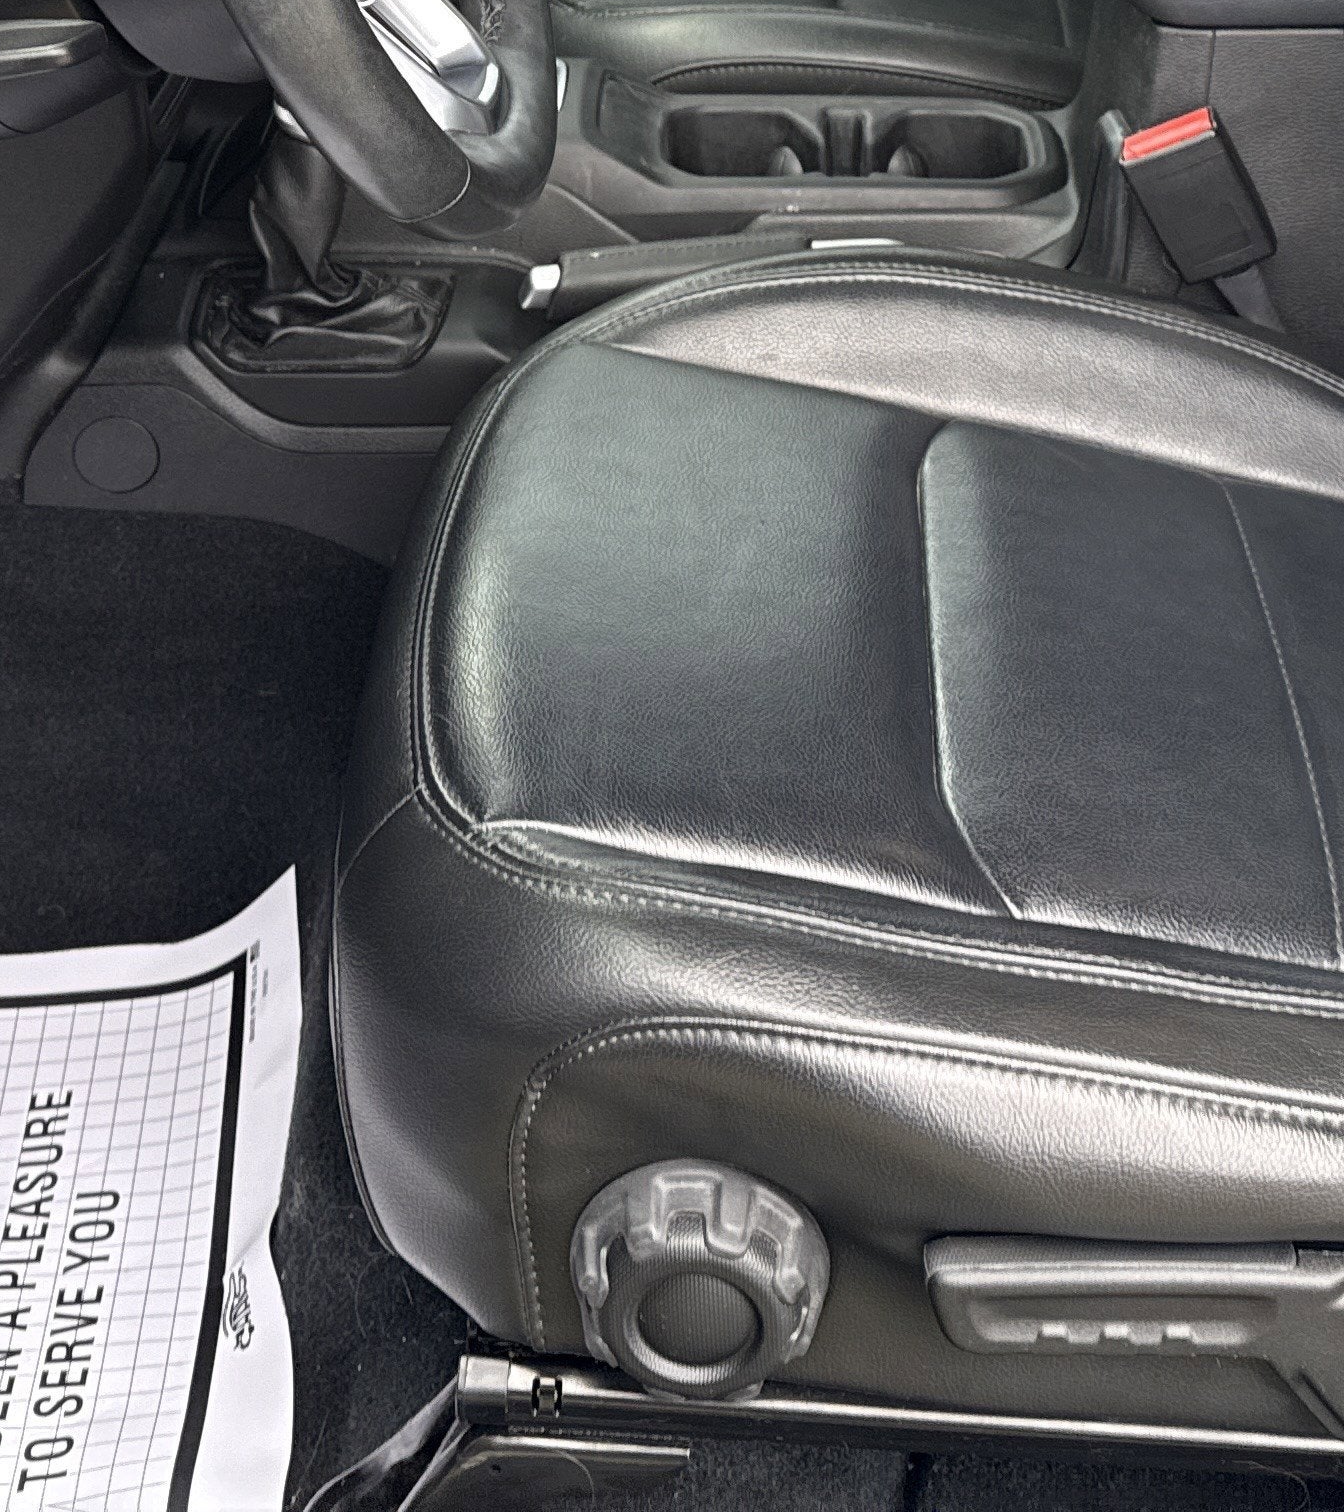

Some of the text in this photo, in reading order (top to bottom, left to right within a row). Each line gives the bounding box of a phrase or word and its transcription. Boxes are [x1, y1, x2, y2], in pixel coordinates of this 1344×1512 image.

[17, 1190, 120, 1494] TO SERVE YOU
